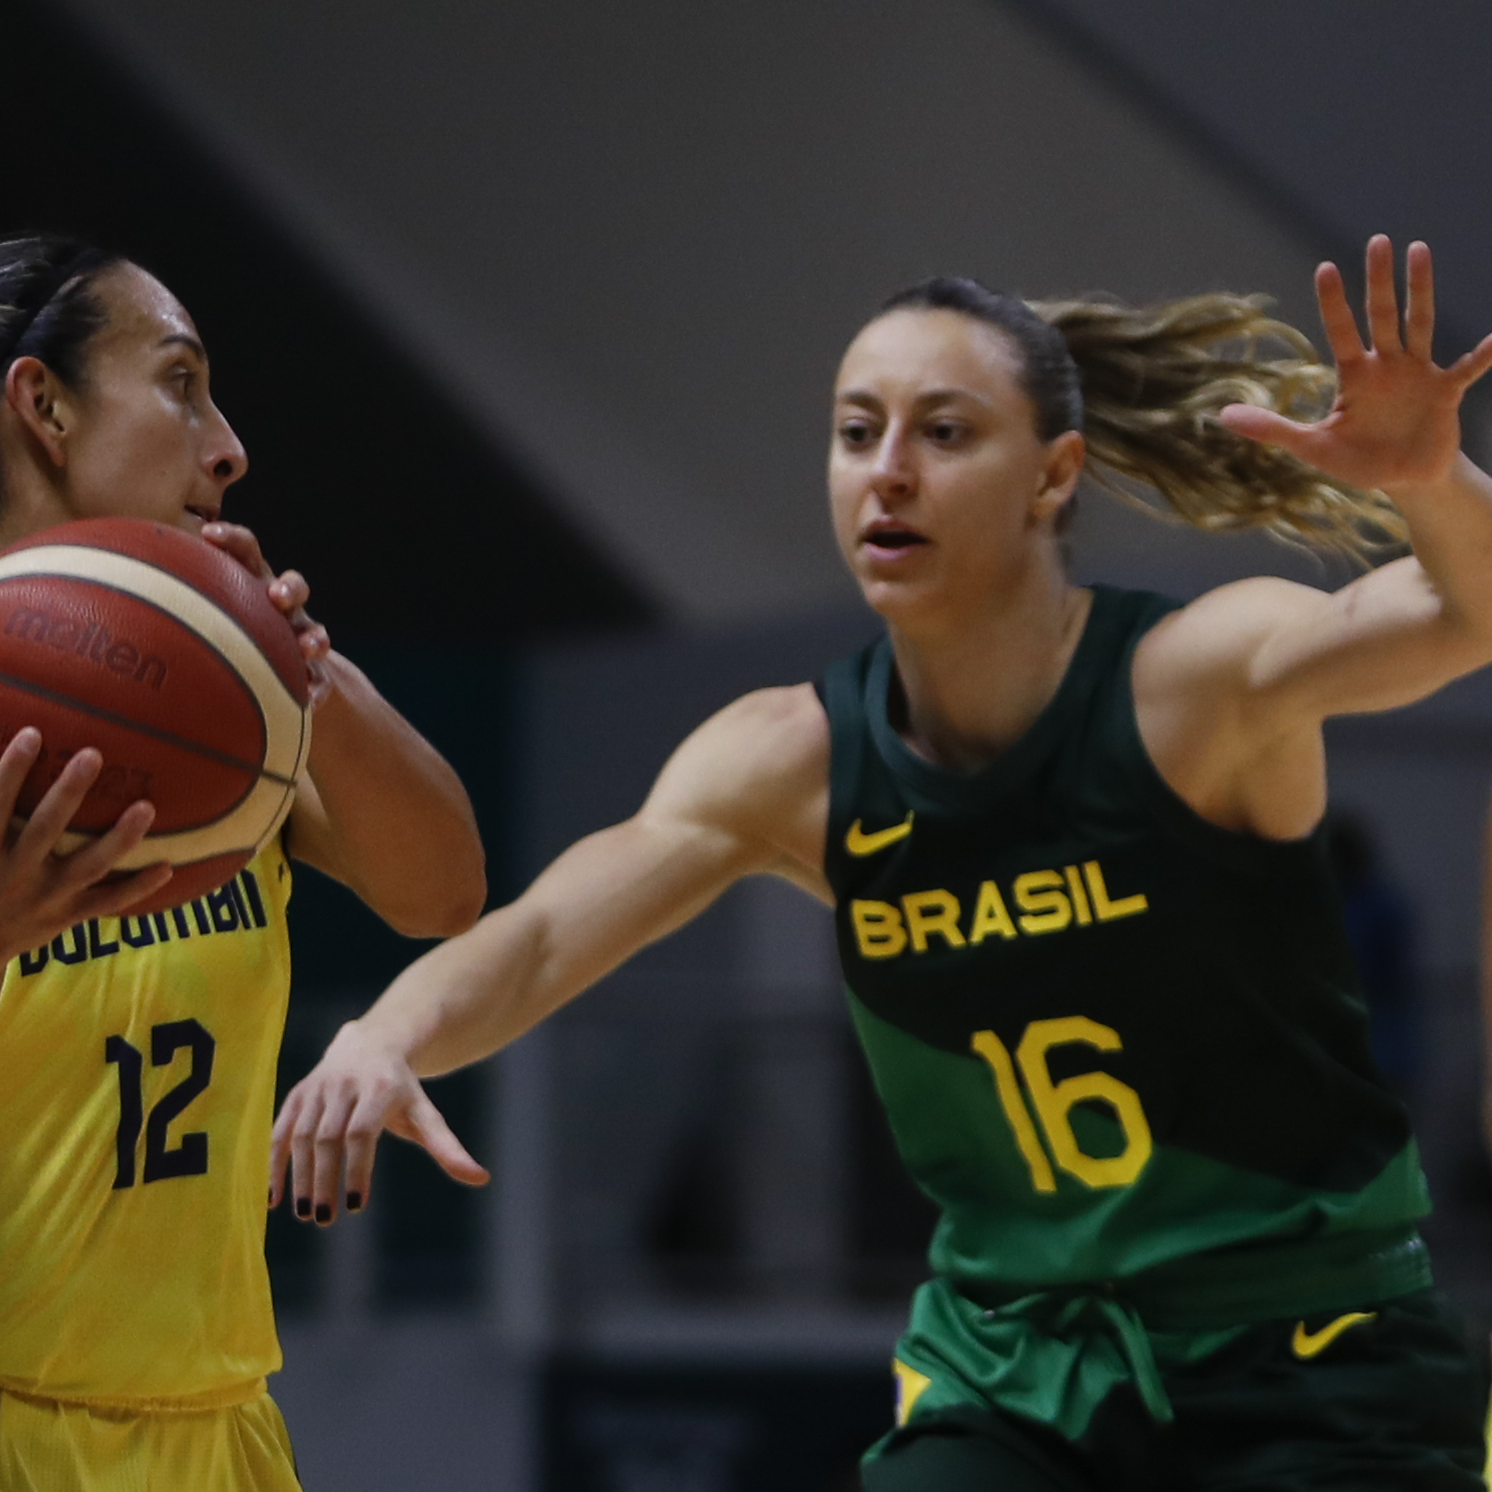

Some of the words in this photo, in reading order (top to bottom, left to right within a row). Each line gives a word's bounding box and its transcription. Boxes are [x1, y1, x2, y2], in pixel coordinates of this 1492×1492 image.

[4, 606, 168, 690] molten
[850, 859, 1151, 961] BRASIL
[105, 1018, 216, 1190] 12
[969, 1014, 1155, 1194] 16
